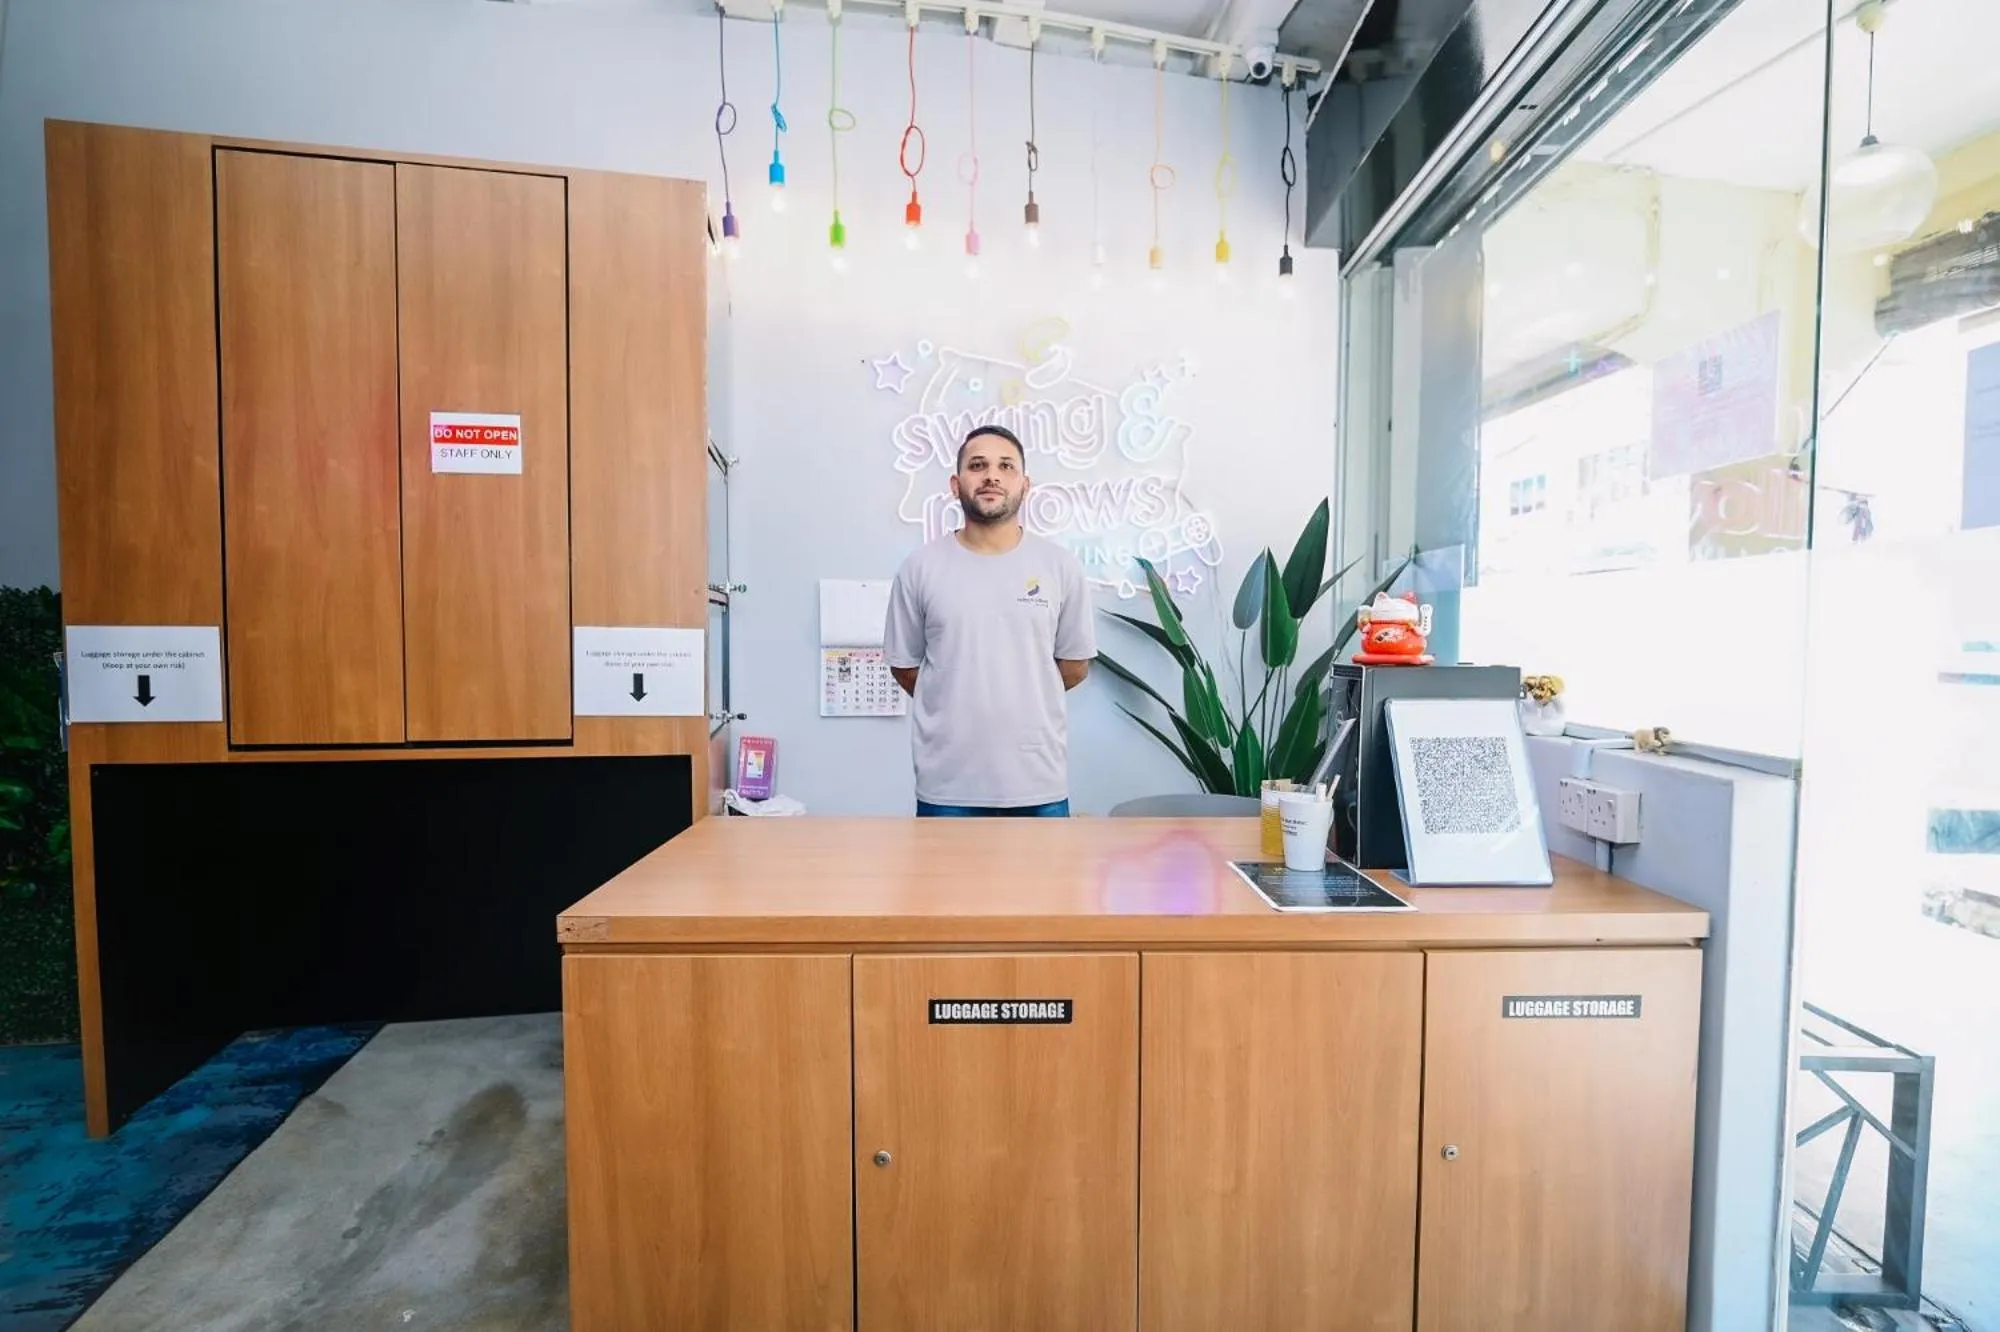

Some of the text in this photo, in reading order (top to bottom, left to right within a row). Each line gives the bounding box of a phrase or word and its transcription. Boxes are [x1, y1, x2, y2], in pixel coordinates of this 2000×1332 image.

[1118, 383, 1175, 462] &
[434, 428, 518, 440] DO NOT OPEN
[440, 448, 513, 460] STAFF ONLY
[935, 1002, 1065, 1020] LUGGAGE STORAGE
[1508, 1000, 1634, 1017] LUGGAGE STORAGE
